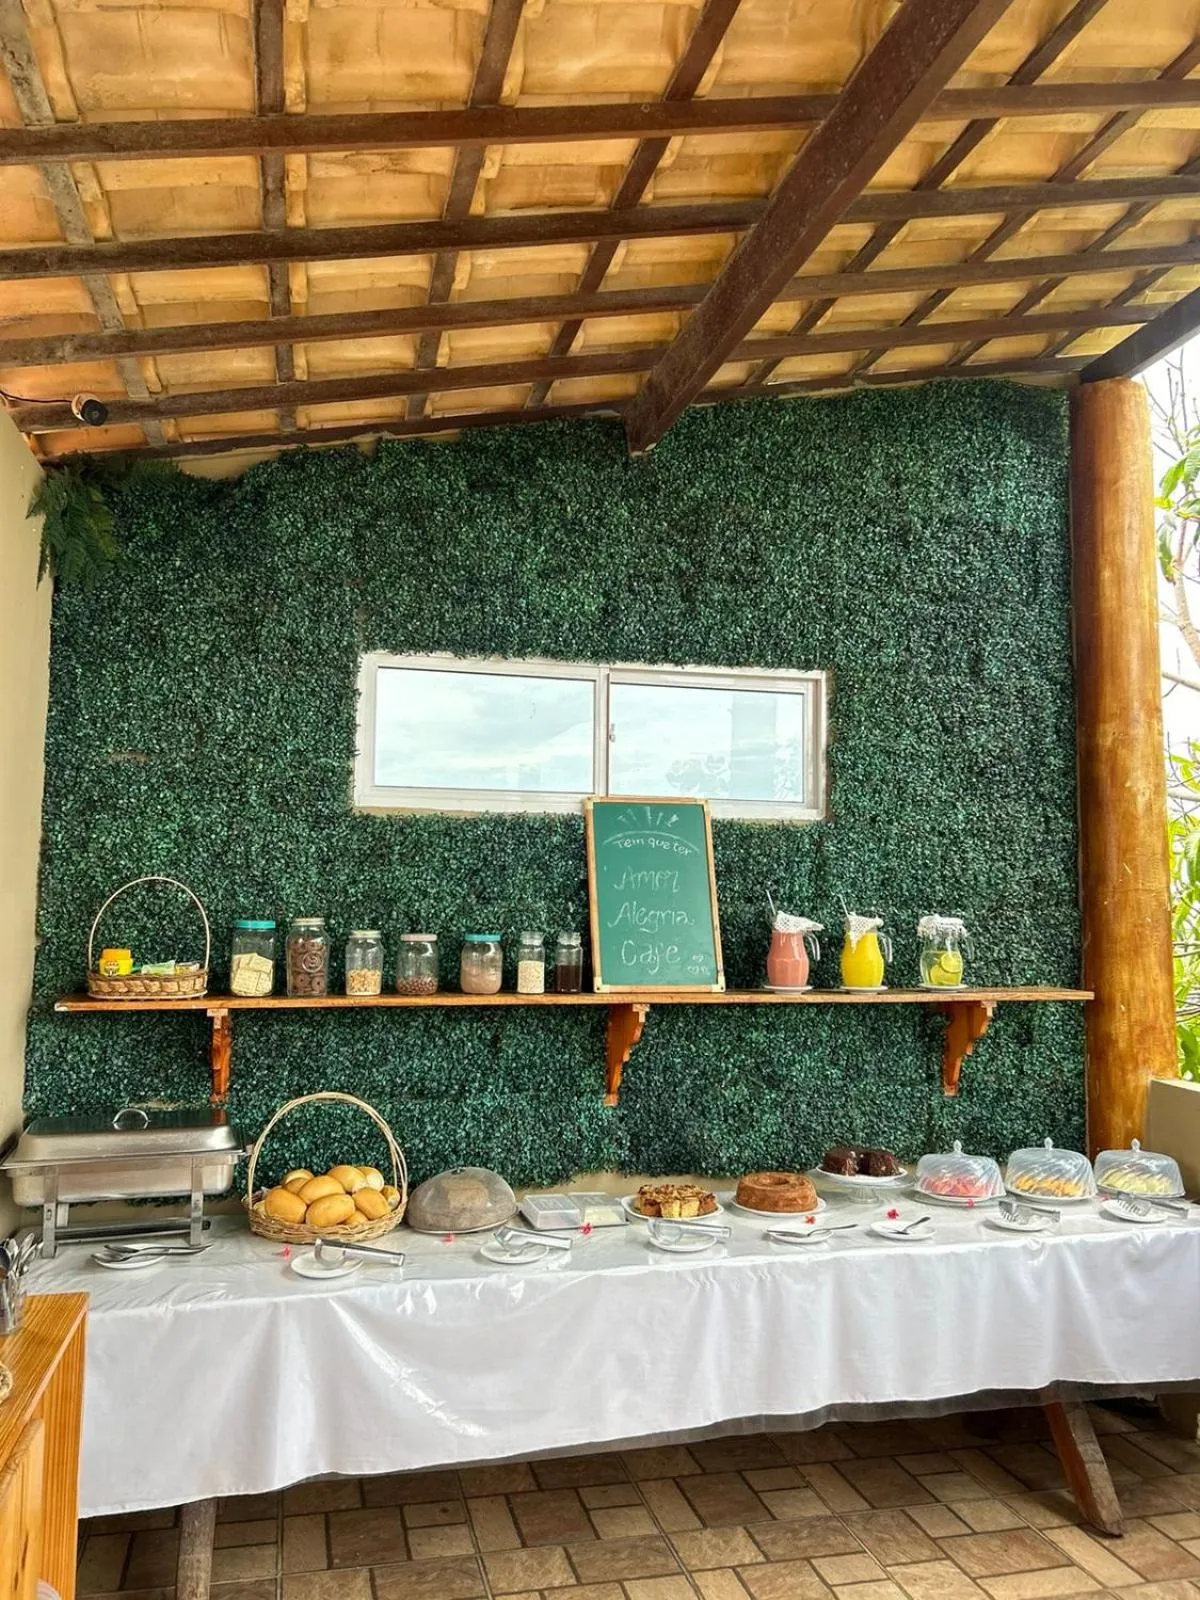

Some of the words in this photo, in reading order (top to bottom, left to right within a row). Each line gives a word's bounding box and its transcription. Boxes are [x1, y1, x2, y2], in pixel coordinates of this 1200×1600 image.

[612, 838, 645, 849] Tem
[648, 837, 671, 850] que
[673, 841, 693, 857] ter
